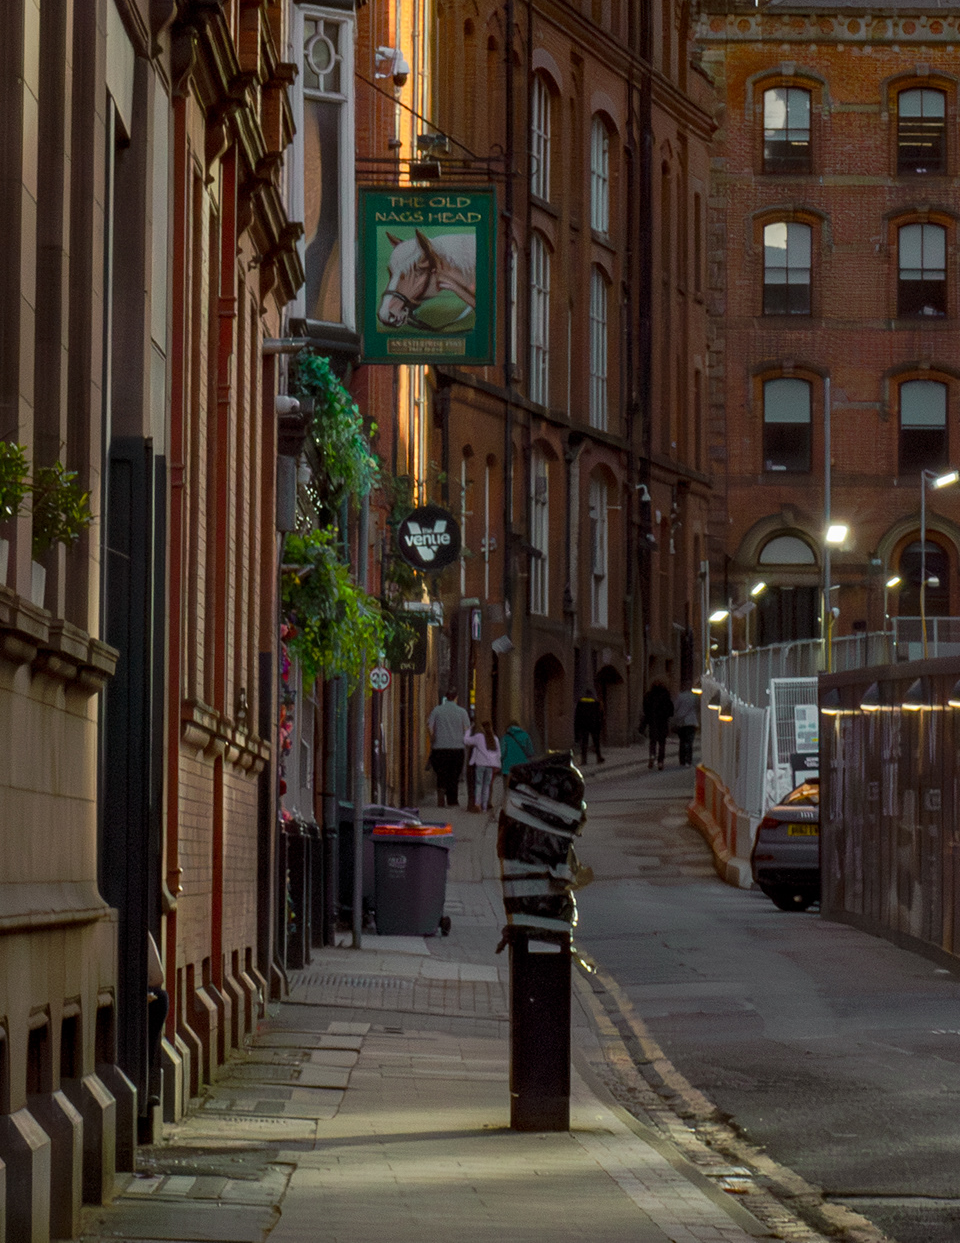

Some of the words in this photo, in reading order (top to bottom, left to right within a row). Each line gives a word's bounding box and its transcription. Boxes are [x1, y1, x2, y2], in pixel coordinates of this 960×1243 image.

[388, 196, 425, 208] THE
[429, 196, 471, 208] OLD
[375, 211, 424, 223] NAGS
[428, 211, 481, 223] HEAD
[404, 533, 451, 547] venue
[372, 672, 389, 685] 20
